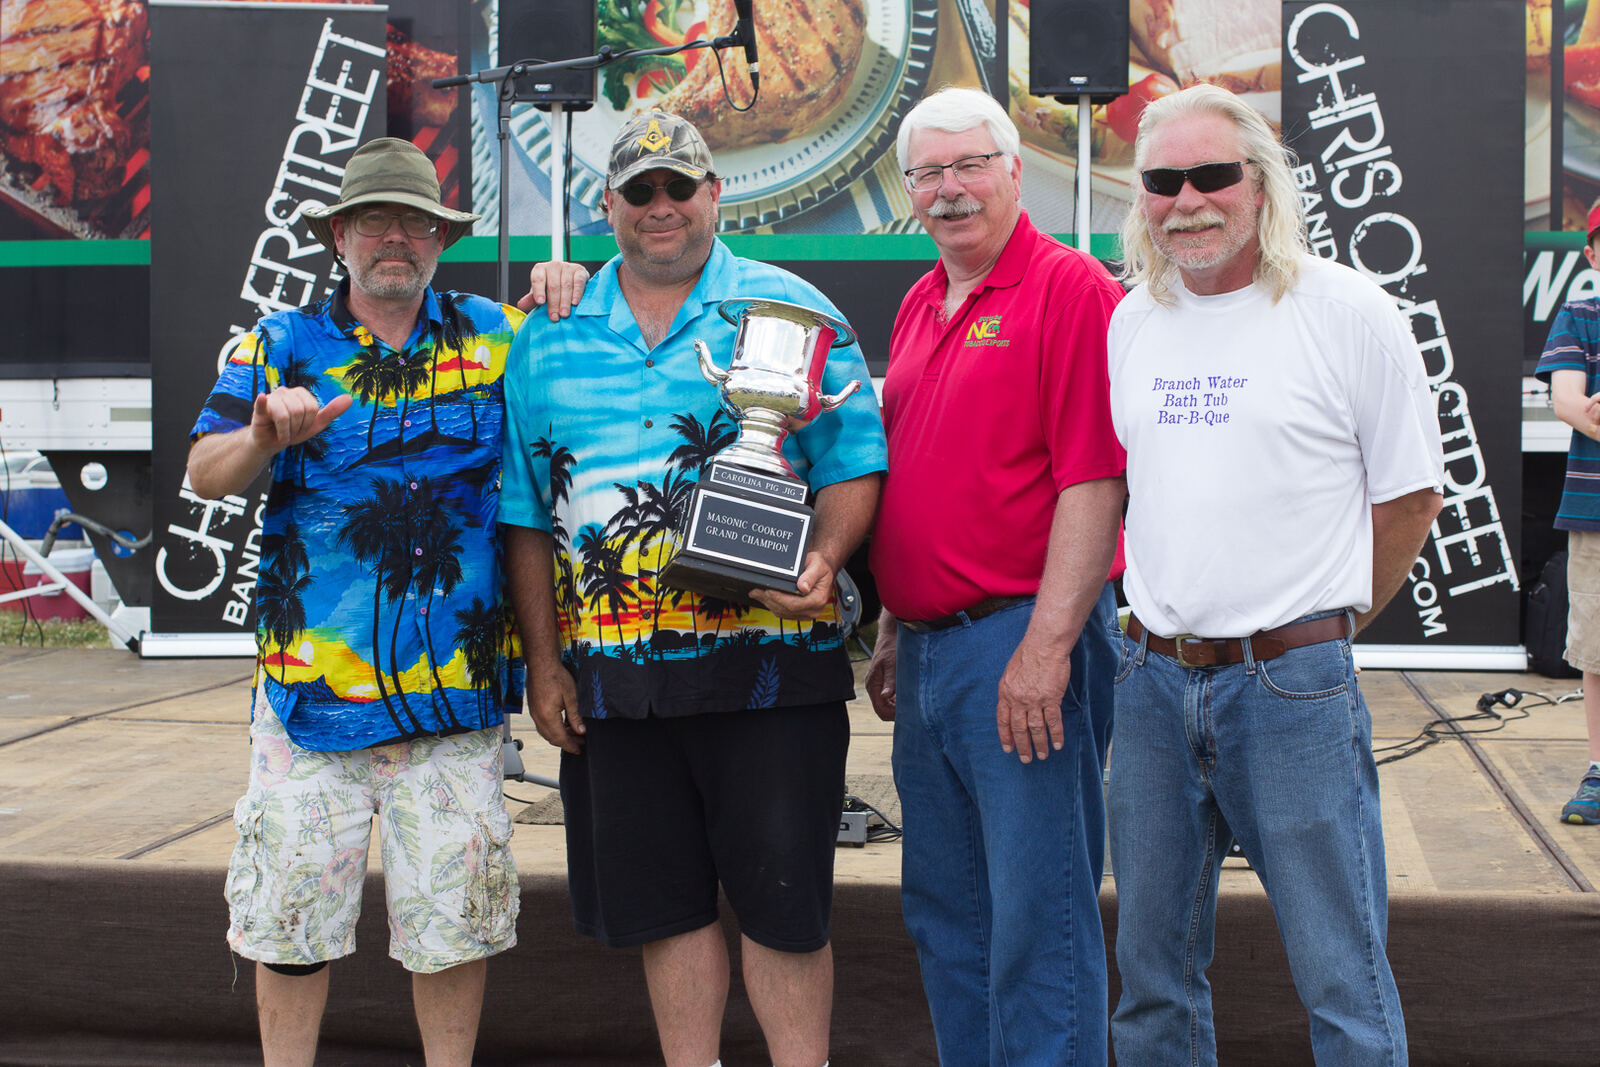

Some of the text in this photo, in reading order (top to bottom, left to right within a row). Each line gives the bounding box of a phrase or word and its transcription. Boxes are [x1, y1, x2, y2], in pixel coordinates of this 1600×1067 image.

[1287, 3, 1403, 209] CHRIS
[1152, 376, 1248, 391] Branch Water
[1163, 393, 1228, 407] Bath Tub
[1157, 410, 1230, 426] Bar-B-Que
[721, 471, 796, 496] CAROLINA PIG JIG
[705, 525, 789, 552] GRAND CHAMPION
[706, 512, 793, 540] MASONIC COOKOFF
